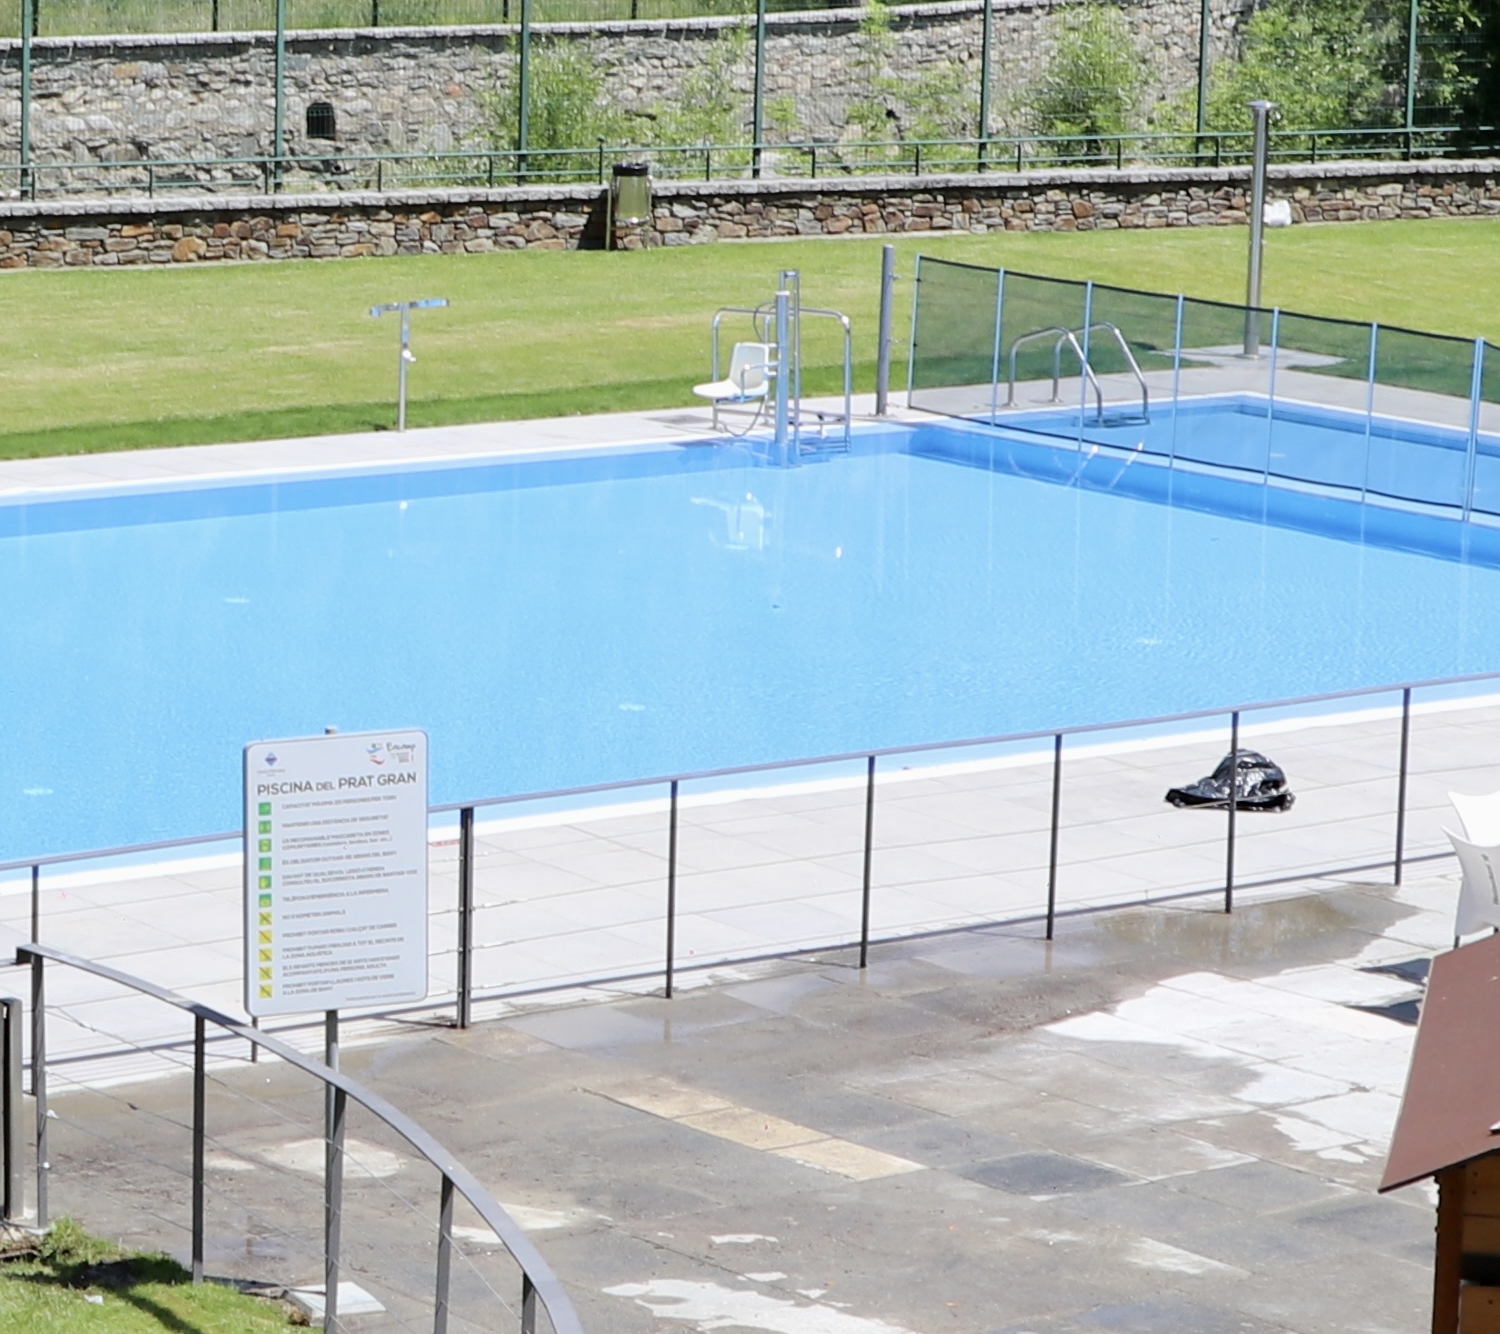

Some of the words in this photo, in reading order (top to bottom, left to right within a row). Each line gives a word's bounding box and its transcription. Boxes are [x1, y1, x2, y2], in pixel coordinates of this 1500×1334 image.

[257, 780, 313, 796] PISCINA
[315, 781, 335, 791] DEL
[338, 775, 374, 789] PRAT
[377, 771, 417, 786] GRAN
